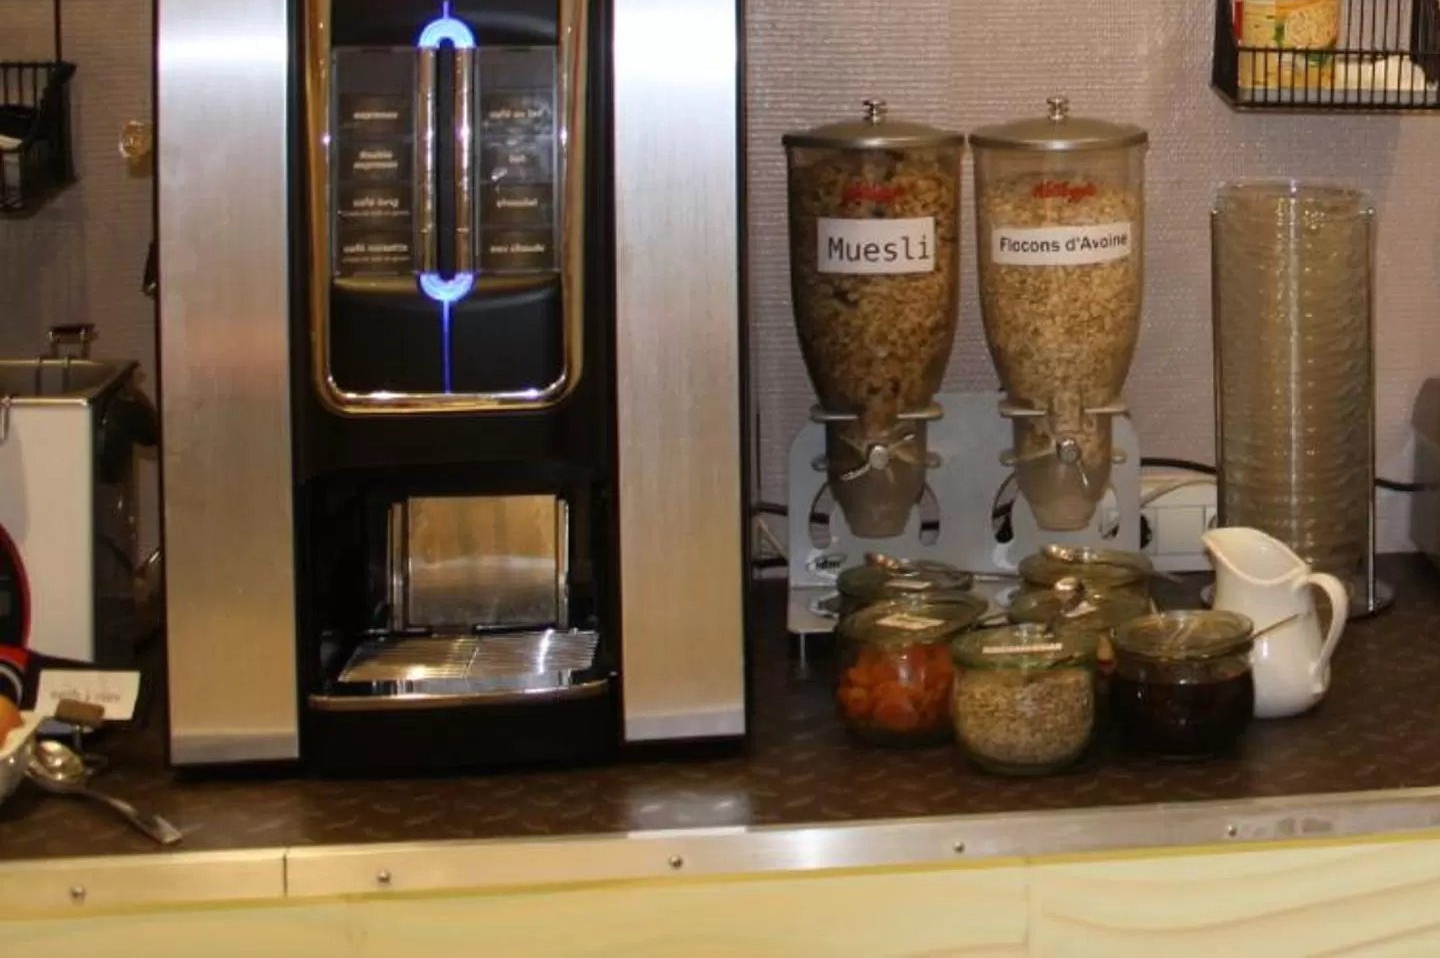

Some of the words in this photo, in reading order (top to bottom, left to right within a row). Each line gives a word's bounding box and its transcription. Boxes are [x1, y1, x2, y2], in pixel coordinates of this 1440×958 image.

[828, 235, 930, 261] Muesli
[1000, 237, 1060, 253] Flocons
[1066, 232, 1128, 252] d'Avoine
